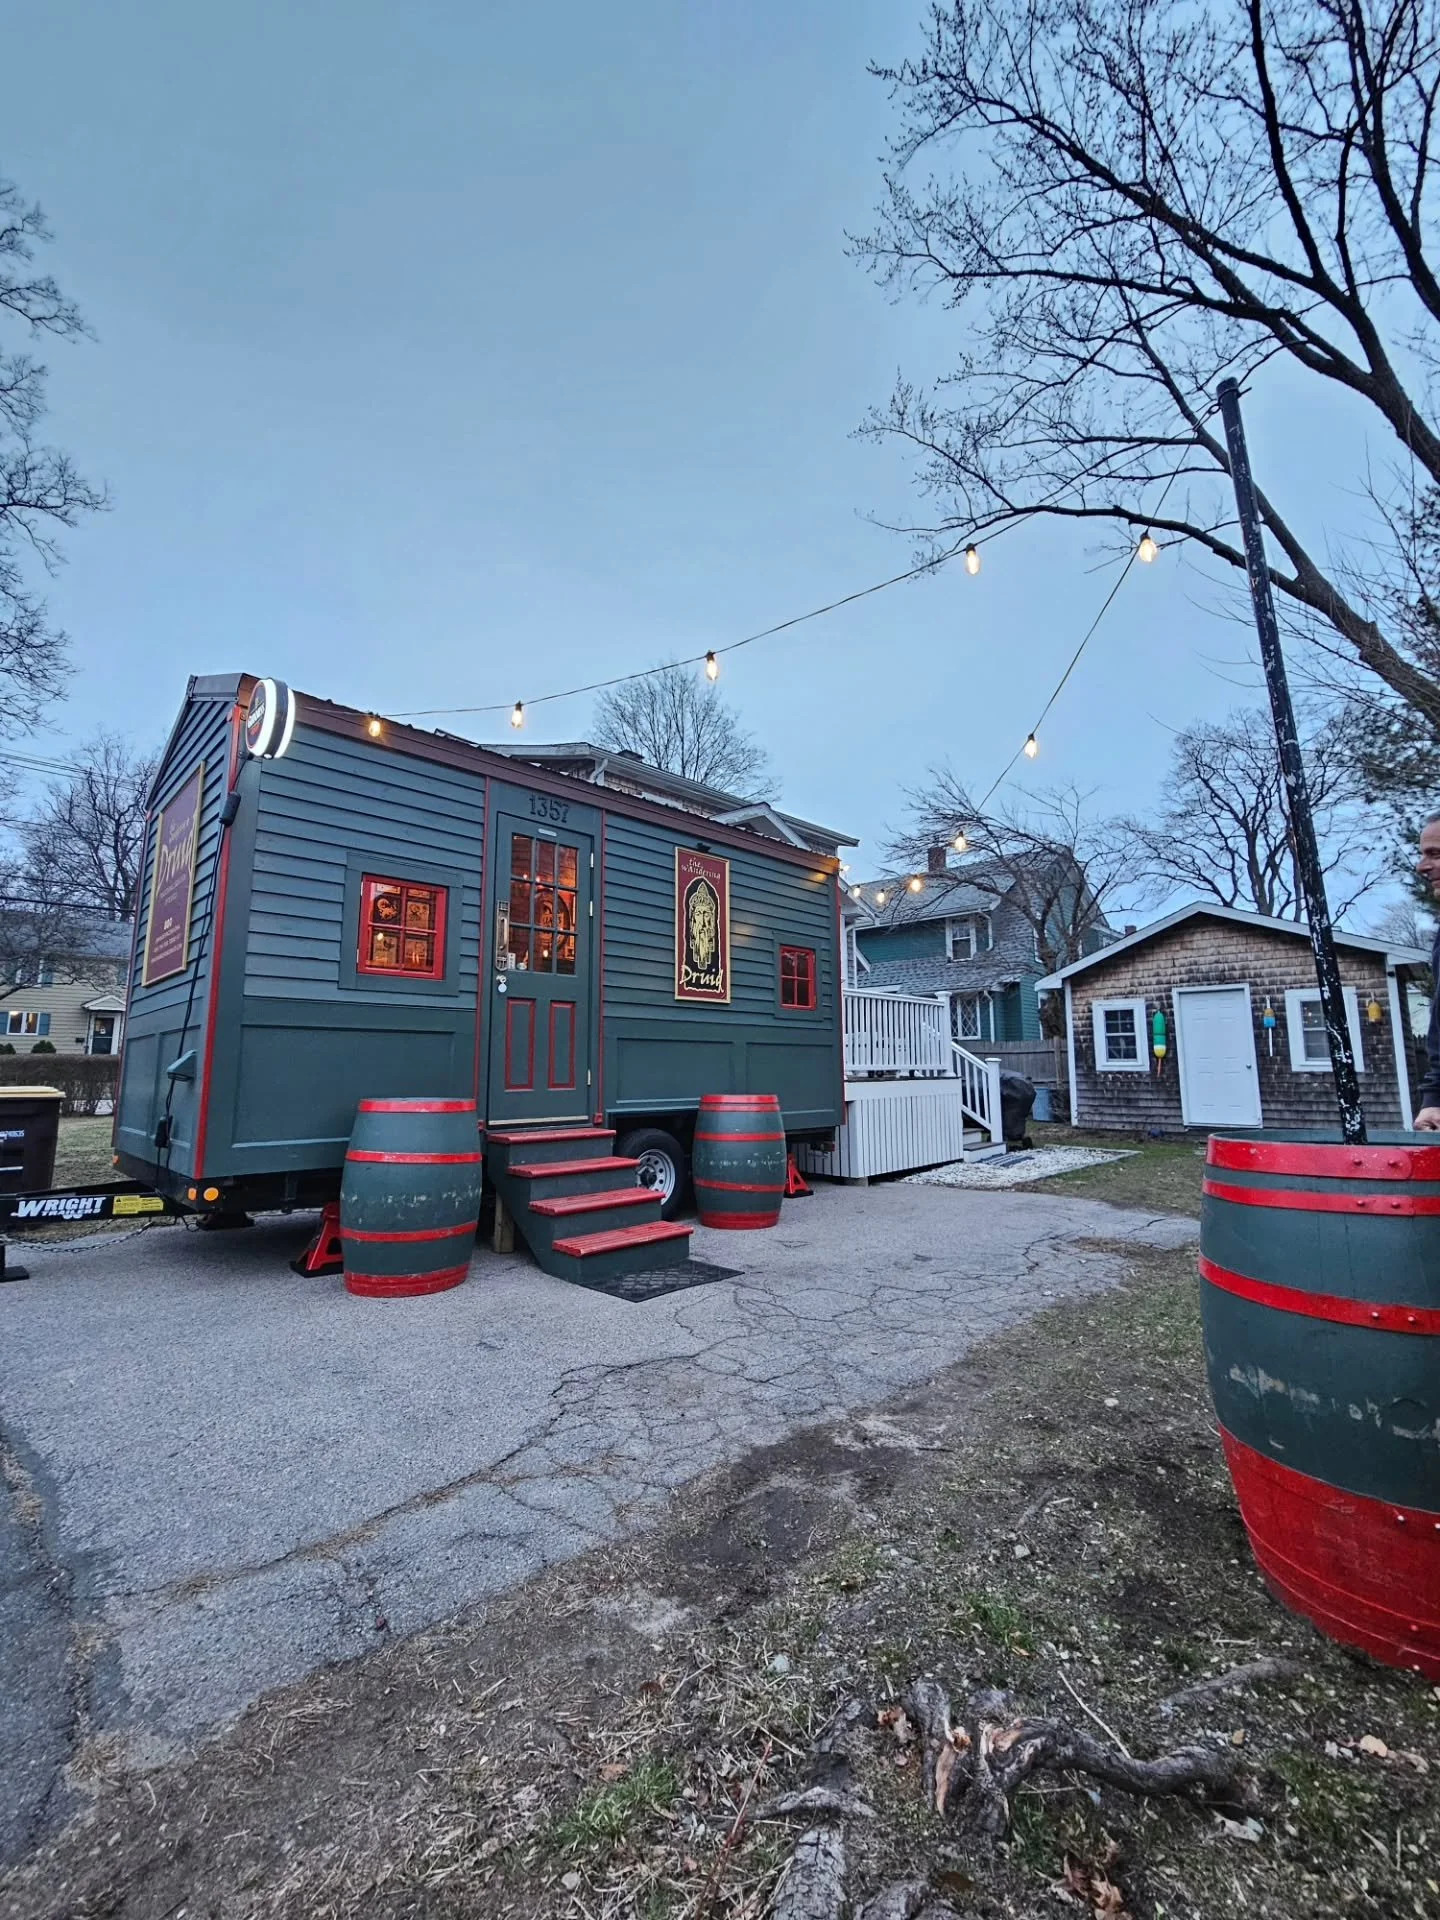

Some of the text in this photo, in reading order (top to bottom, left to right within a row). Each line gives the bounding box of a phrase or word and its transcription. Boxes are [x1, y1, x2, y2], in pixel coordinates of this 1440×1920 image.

[529, 794, 569, 823] 1357
[679, 964, 725, 993] Druid
[18, 1197, 107, 1217] WRIGHT
